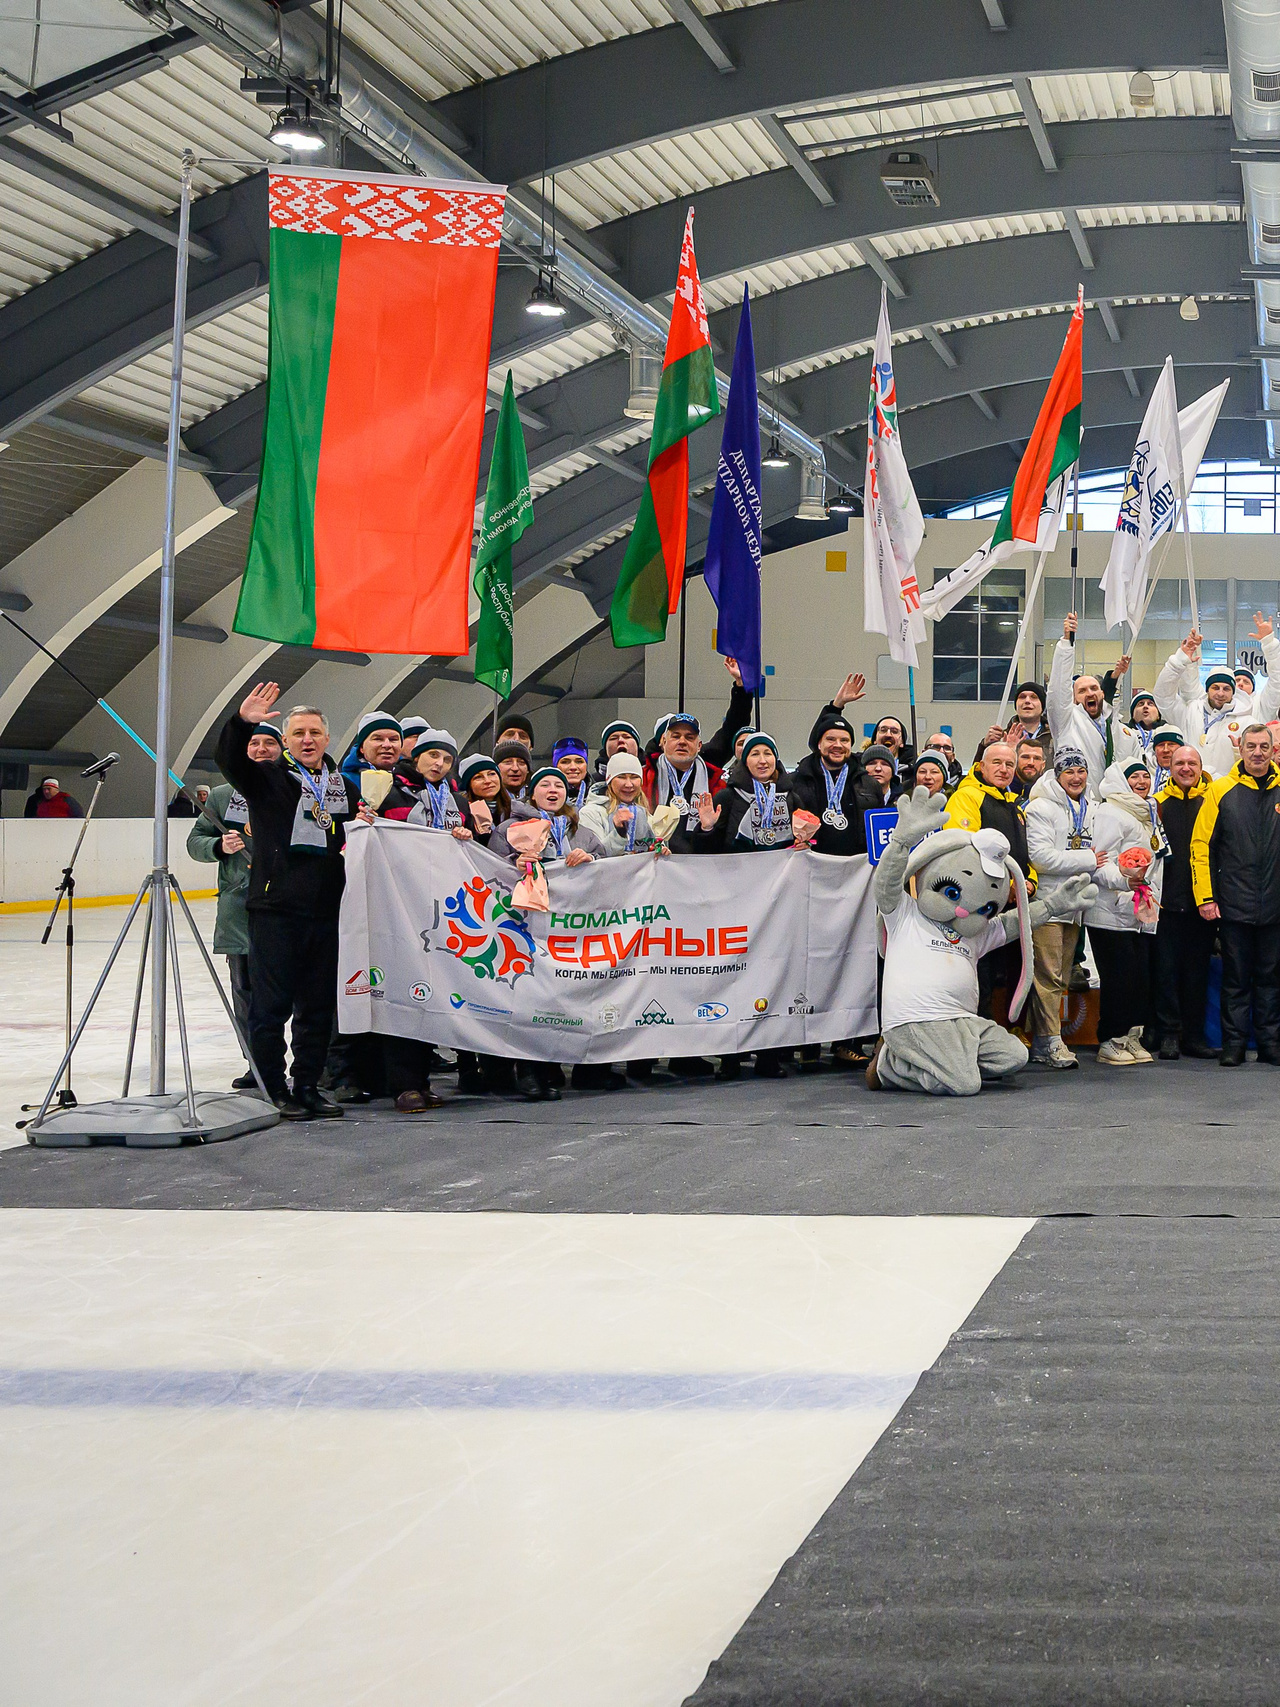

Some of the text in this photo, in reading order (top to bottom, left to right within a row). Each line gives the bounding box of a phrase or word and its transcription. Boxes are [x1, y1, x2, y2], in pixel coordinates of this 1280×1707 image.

[717, 453, 751, 529] ИТАРНОЙ
[550, 904, 672, 929] КОМАНДА
[547, 925, 748, 968] ЕДИНЫЕ
[555, 969, 588, 981] КОГДА
[590, 970, 608, 980] МЫ
[609, 968, 636, 980] ЕДИНЫ
[650, 966, 667, 975] МЫ
[670, 962, 748, 975] НЕПОБЕДИМЫ!
[532, 1016, 583, 1027] ВОСТОЧНЫЙ
